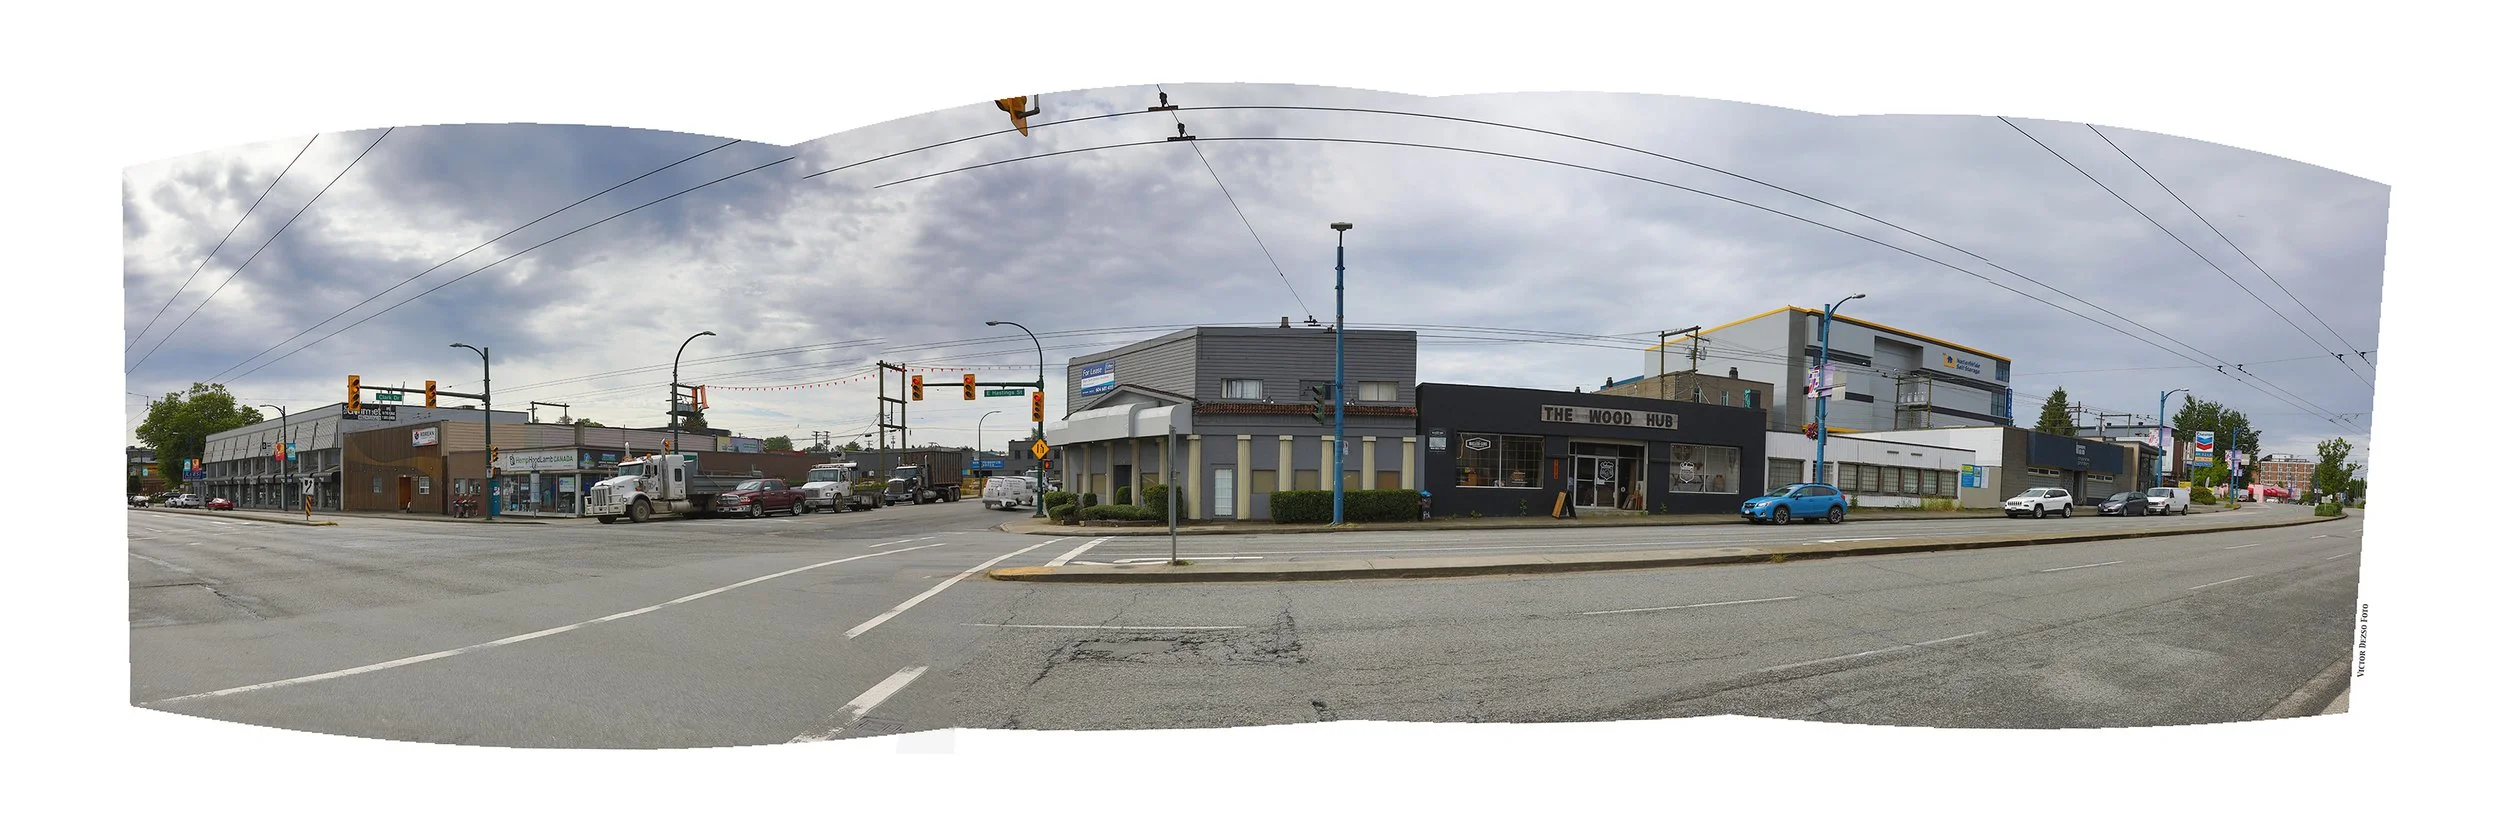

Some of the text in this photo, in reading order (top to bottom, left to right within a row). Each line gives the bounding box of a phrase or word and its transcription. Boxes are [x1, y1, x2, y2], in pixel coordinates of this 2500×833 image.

[1090, 367, 1102, 375] Lease
[1544, 407, 1674, 428] THE WOOD HUB
